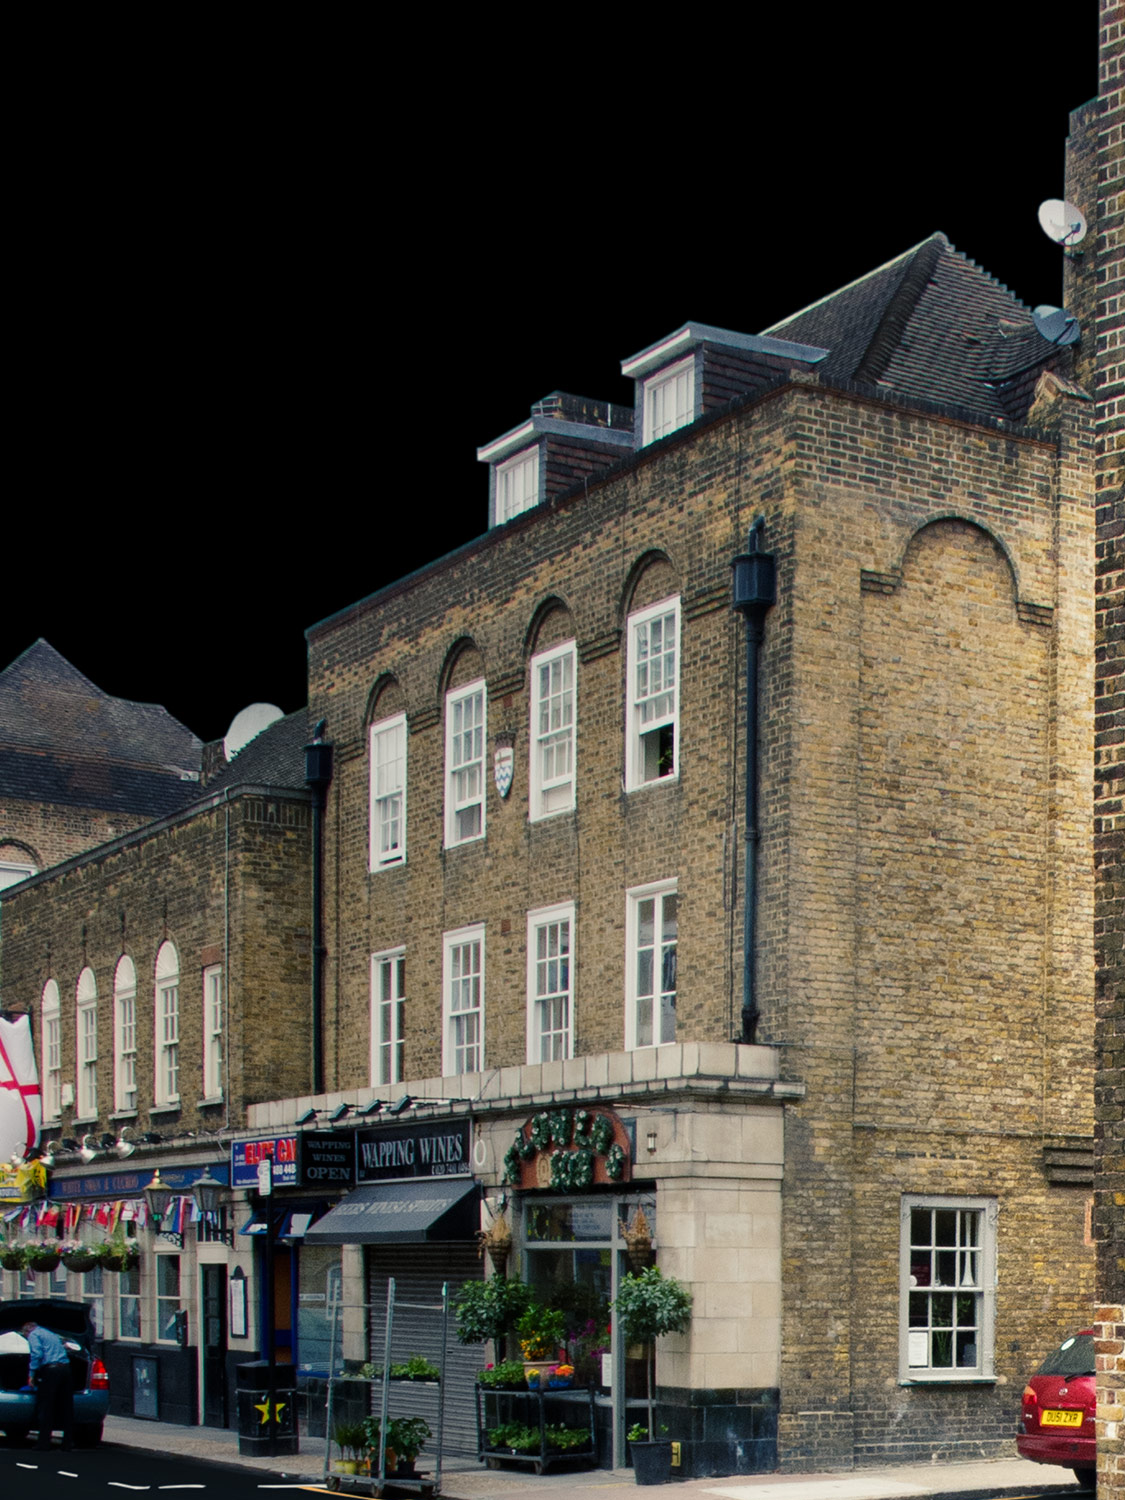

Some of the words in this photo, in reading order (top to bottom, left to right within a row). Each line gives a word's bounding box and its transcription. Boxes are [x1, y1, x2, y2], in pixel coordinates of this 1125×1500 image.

[306, 1140, 351, 1150] WAPPING
[361, 1138, 415, 1168] WAPPING
[419, 1133, 463, 1164] WINES
[312, 1153, 346, 1163] WINES
[307, 1166, 351, 1180] OPEN
